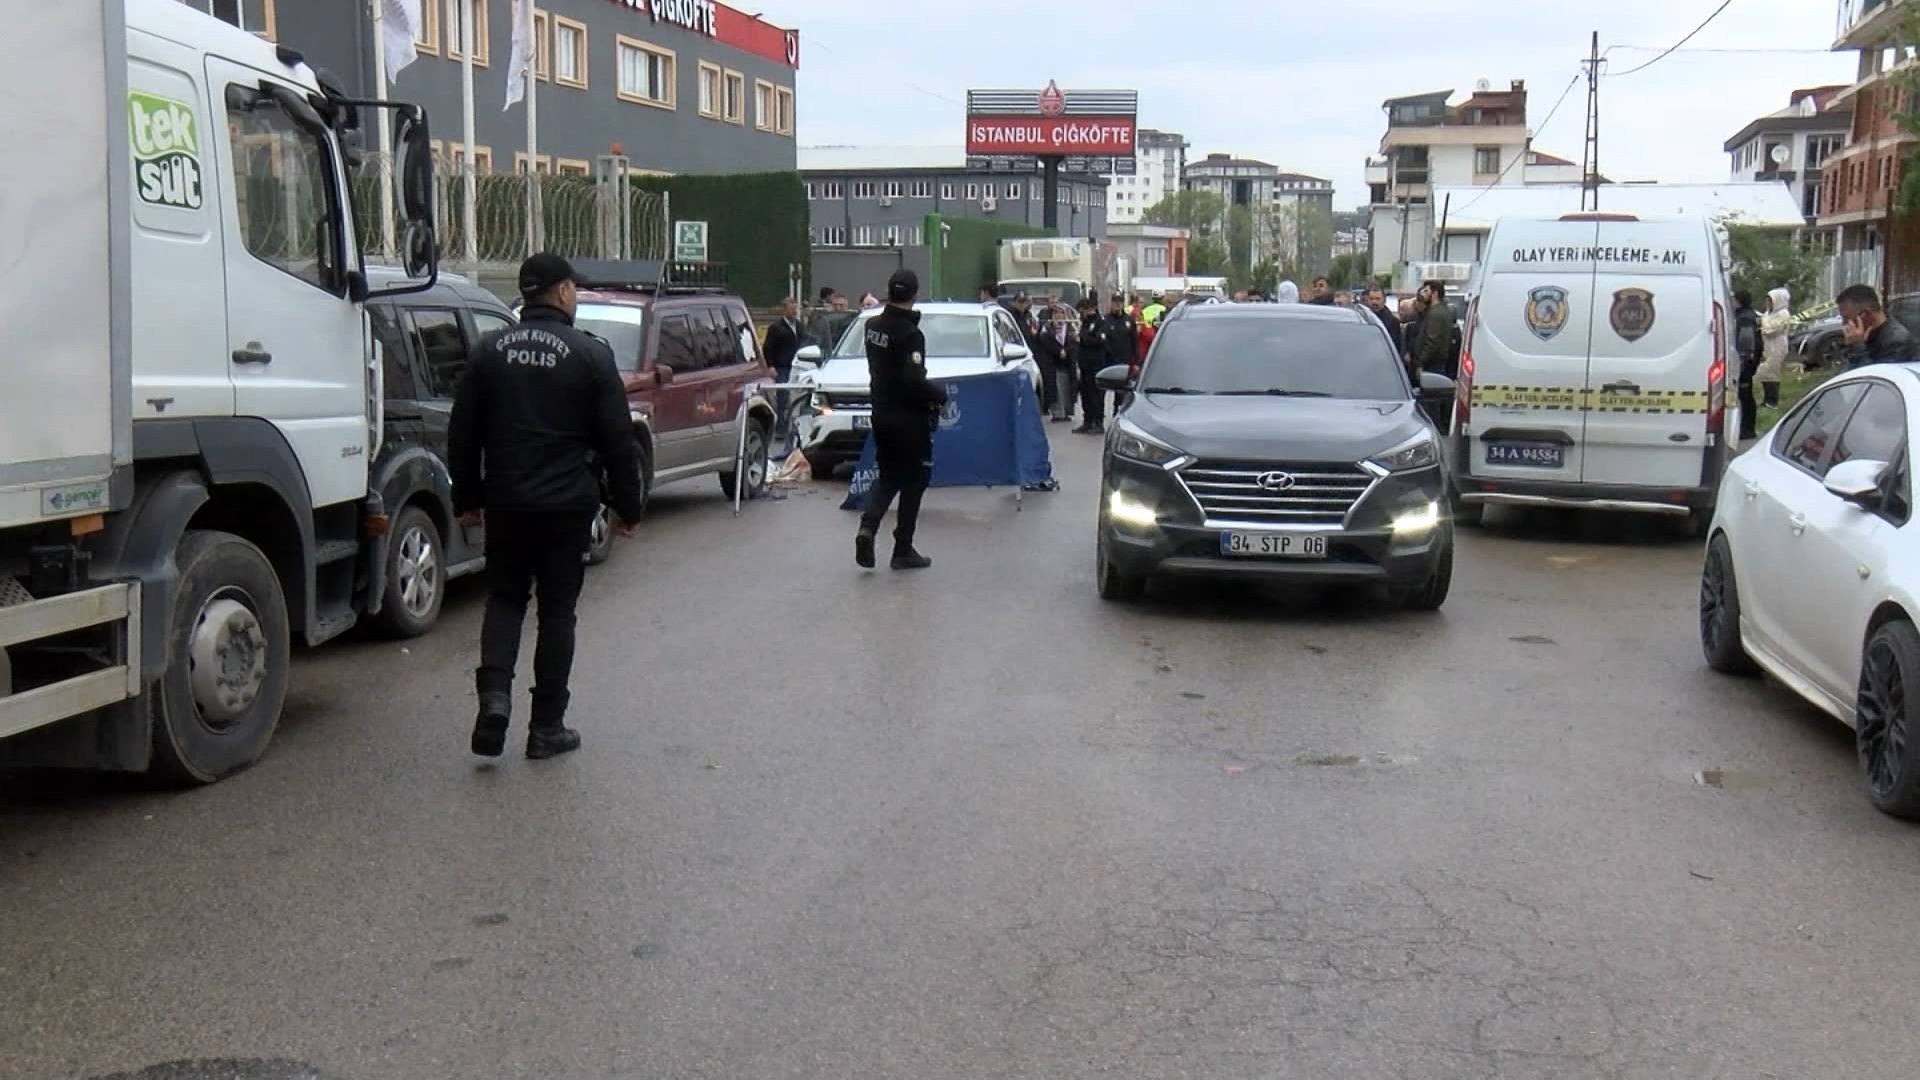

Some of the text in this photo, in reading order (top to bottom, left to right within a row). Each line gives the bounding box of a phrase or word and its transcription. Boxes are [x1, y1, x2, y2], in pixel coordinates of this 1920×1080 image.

[132, 101, 197, 154] tek
[972, 124, 1046, 143] İSTANBUL
[140, 156, 201, 208] süt
[1513, 249, 1546, 262] OLAY
[1490, 446, 1505, 459] 34
[1508, 448, 1519, 458] A
[1231, 535, 1324, 553] 34 STP 06
